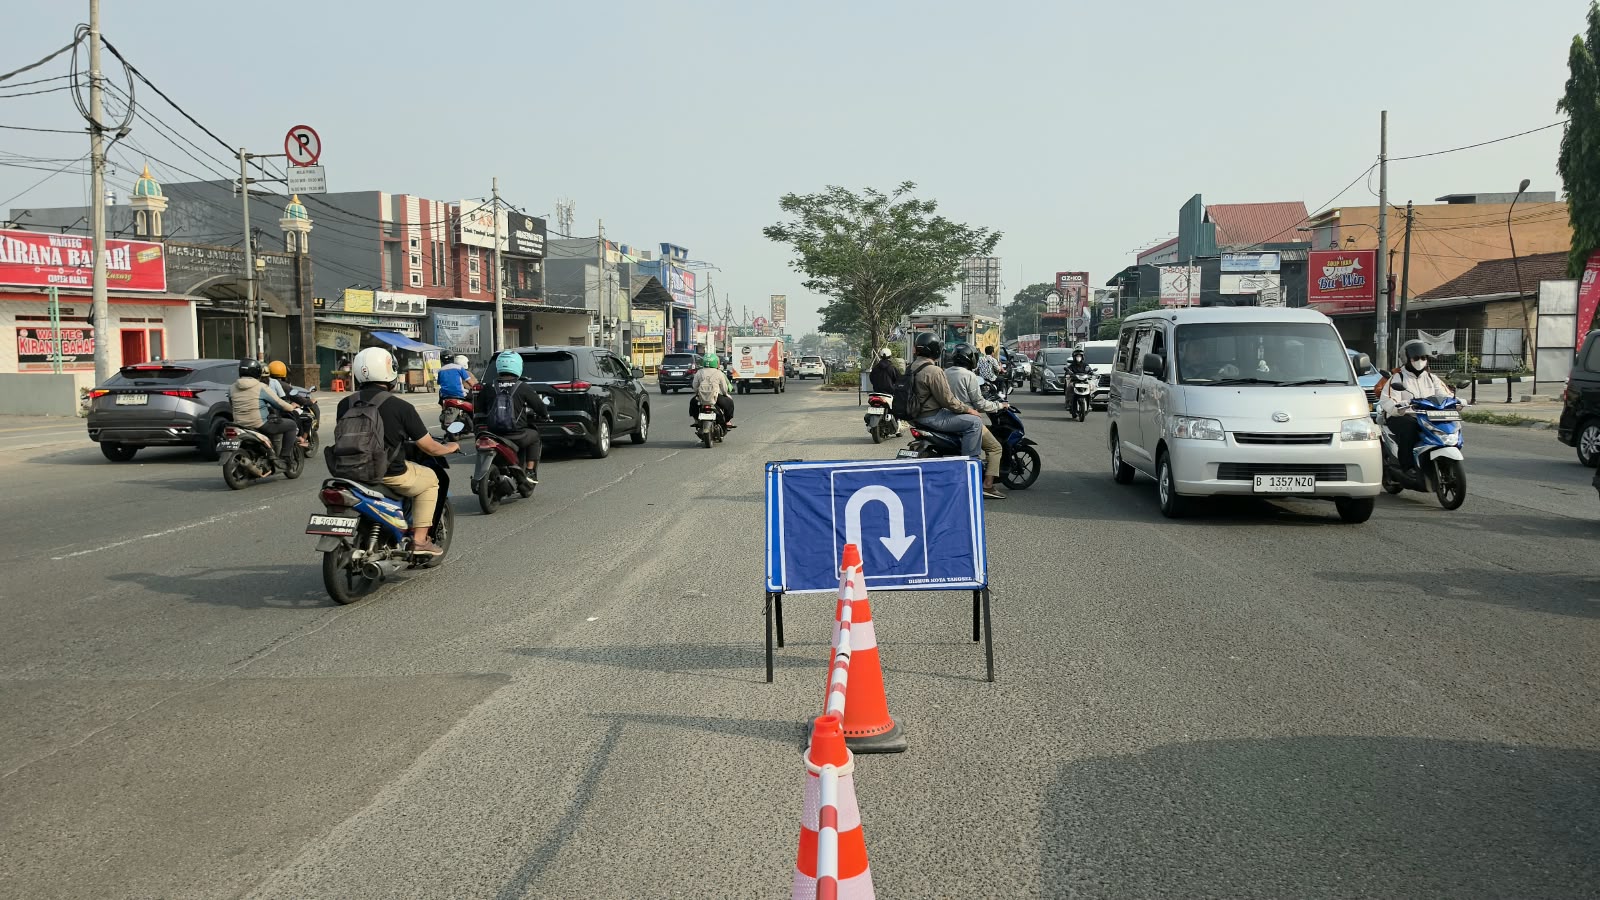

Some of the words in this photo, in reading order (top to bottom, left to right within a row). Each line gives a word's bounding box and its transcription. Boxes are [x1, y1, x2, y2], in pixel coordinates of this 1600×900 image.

[48, 235, 82, 249] WARTEG
[67, 243, 132, 271] BAARI
[168, 245, 204, 258] MASJID
[1318, 276, 1336, 290] Bu
[1340, 272, 1366, 288] Win
[36, 329, 84, 340] WATEG
[1256, 476, 1262, 486] B
[1269, 477, 1293, 486] 1357
[1295, 477, 1313, 486] NZO
